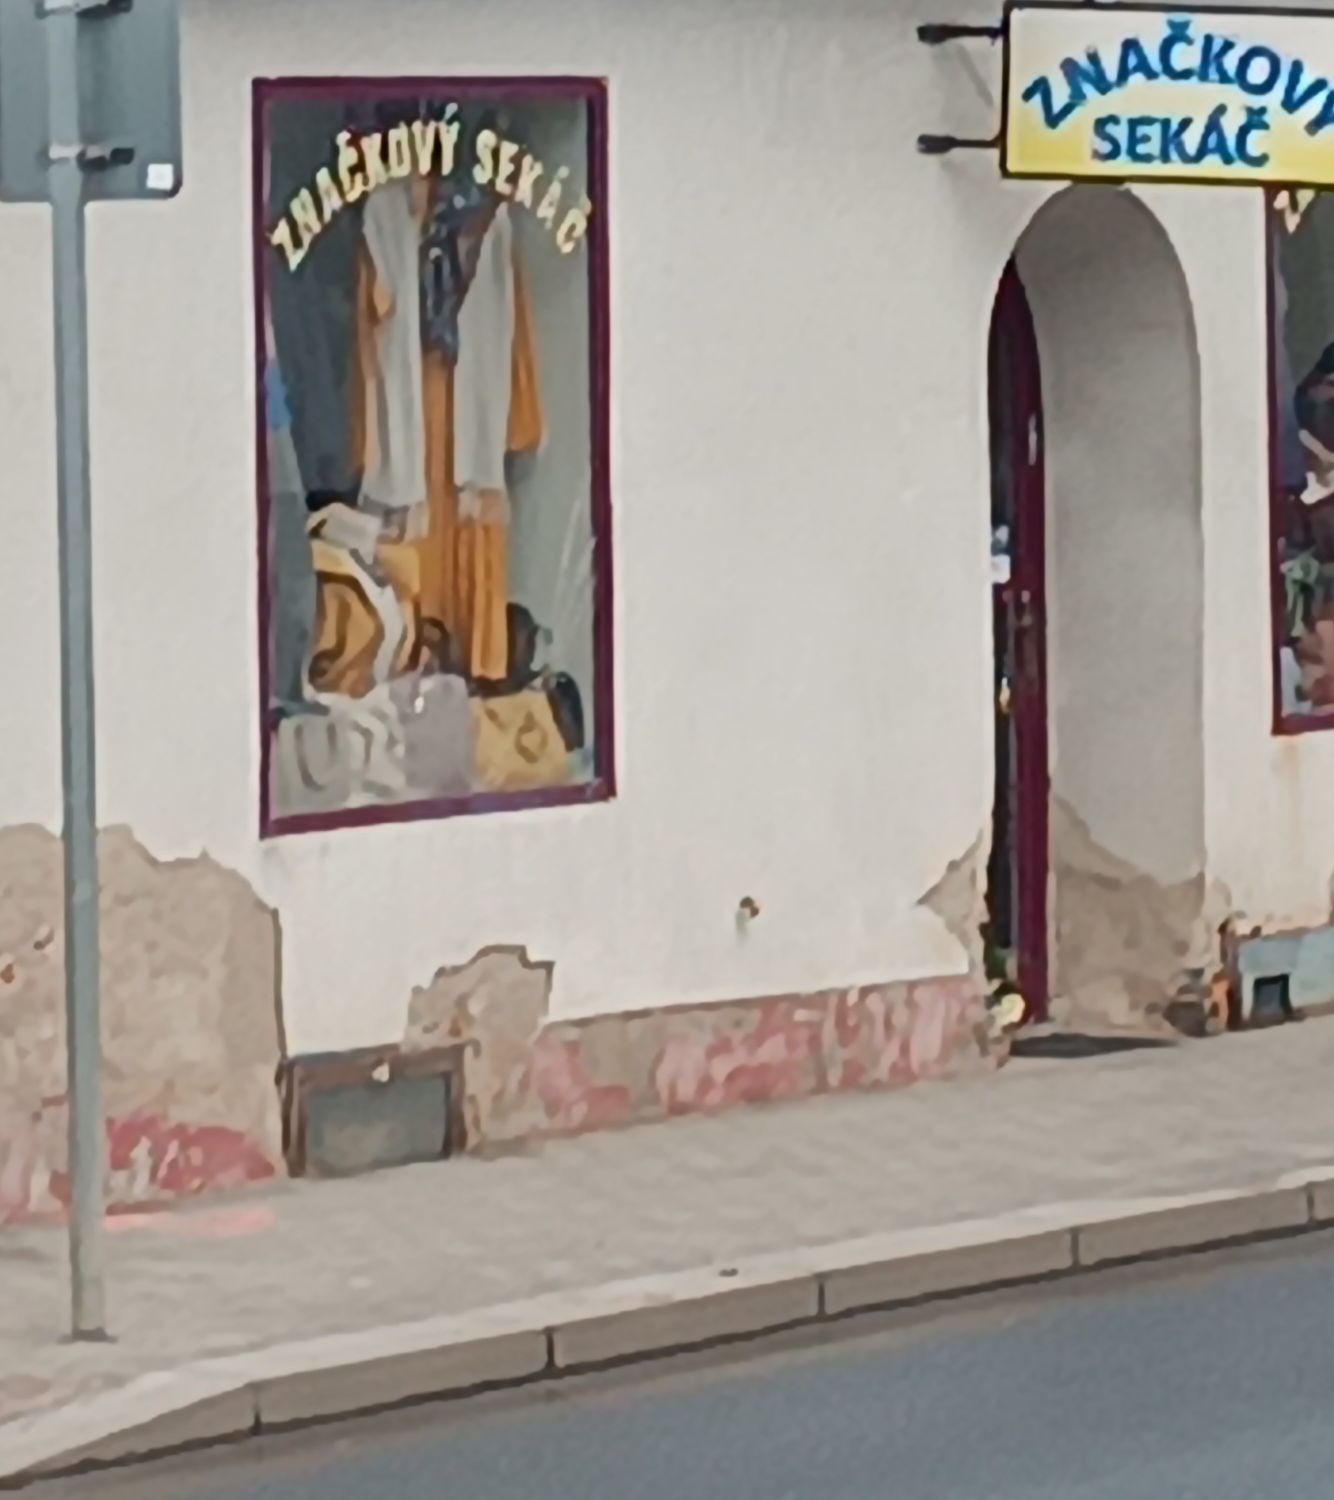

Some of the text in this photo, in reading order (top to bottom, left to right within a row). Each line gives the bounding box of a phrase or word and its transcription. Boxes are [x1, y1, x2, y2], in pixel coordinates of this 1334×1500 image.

[268, 102, 593, 273] ZNAČKOVÝ SEKÁČ
[1090, 103, 1271, 168] SEKÁČ
